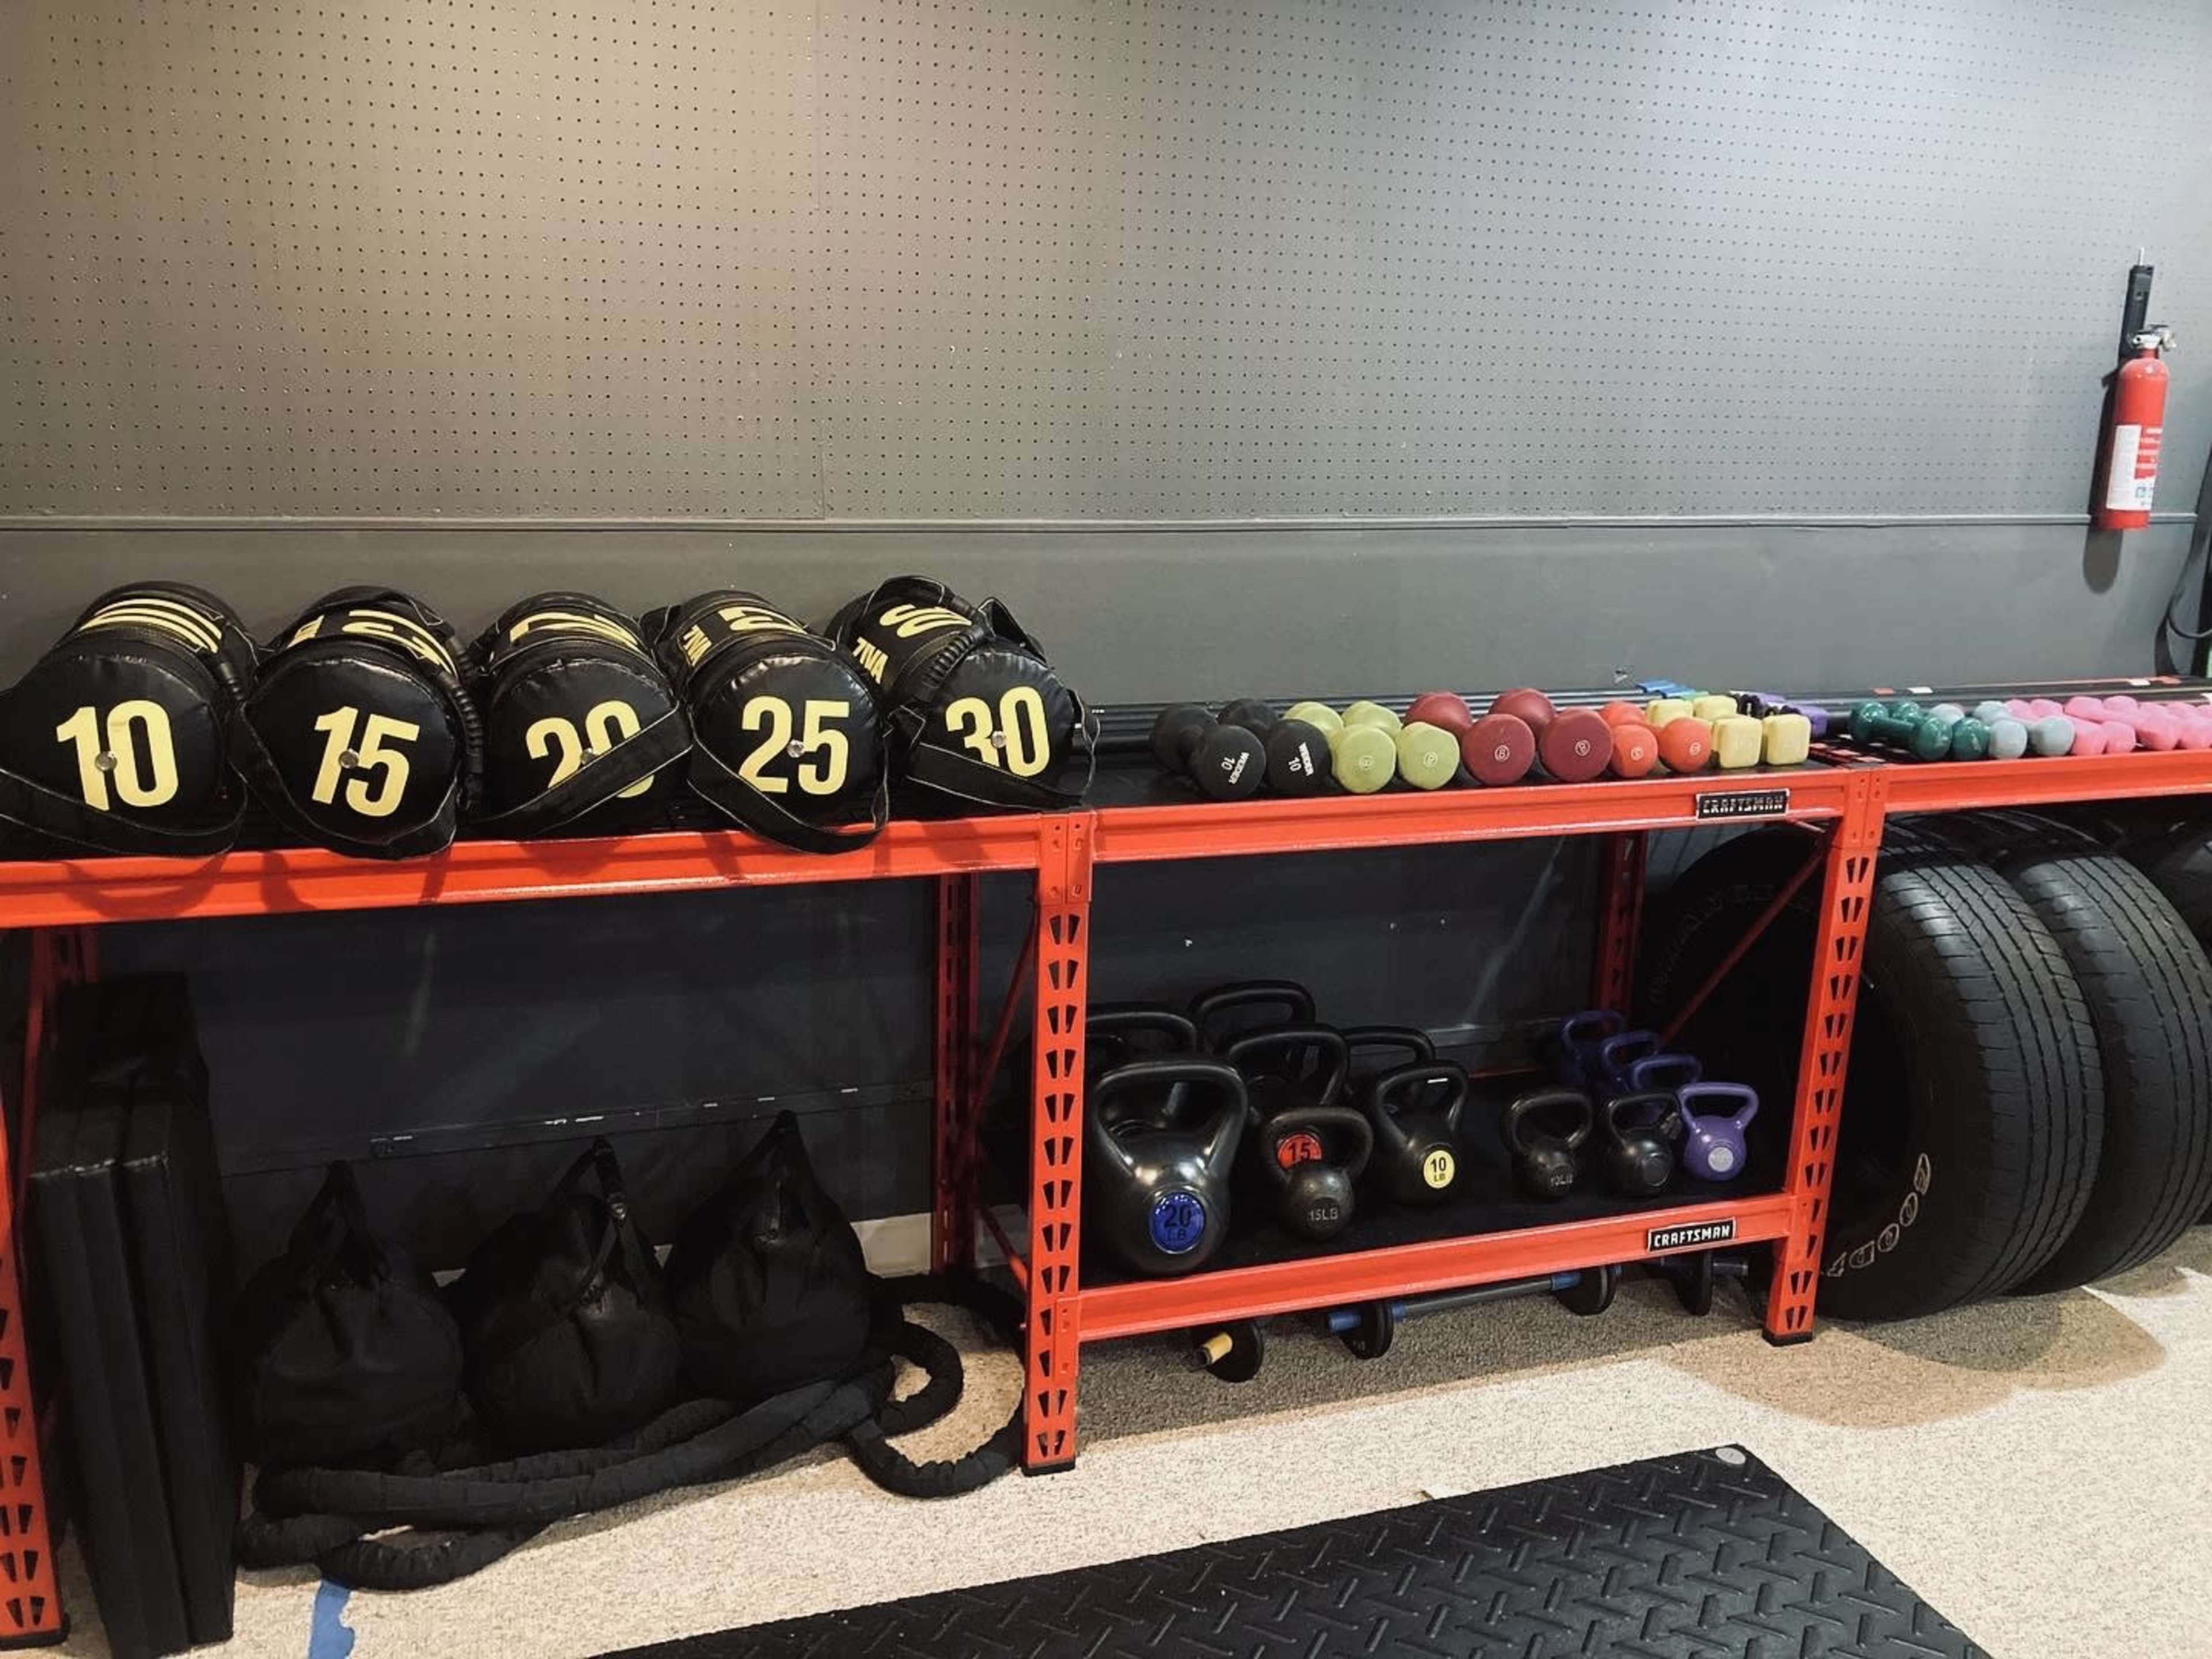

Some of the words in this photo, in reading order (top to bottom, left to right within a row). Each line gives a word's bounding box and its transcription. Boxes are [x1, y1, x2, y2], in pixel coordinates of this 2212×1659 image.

[945, 686, 1050, 778] 30
[56, 699, 179, 811] 10
[525, 699, 653, 798] 20
[738, 695, 850, 795] 25
[312, 706, 419, 817] 15
[1221, 756, 1236, 771] 10
[1288, 756, 1302, 772] 10
[1702, 795, 1784, 814] CRAFTSMAN
[1288, 1141, 1311, 1161] 15
[1430, 1156, 1447, 1173] 10
[1164, 1203, 1192, 1228] 20
[1308, 1207, 1339, 1222] 15LB
[1820, 1153, 1932, 1278] GOODY
[1168, 1228, 1186, 1241] LB
[1653, 1224, 1731, 1248] CRAFTSMAN
